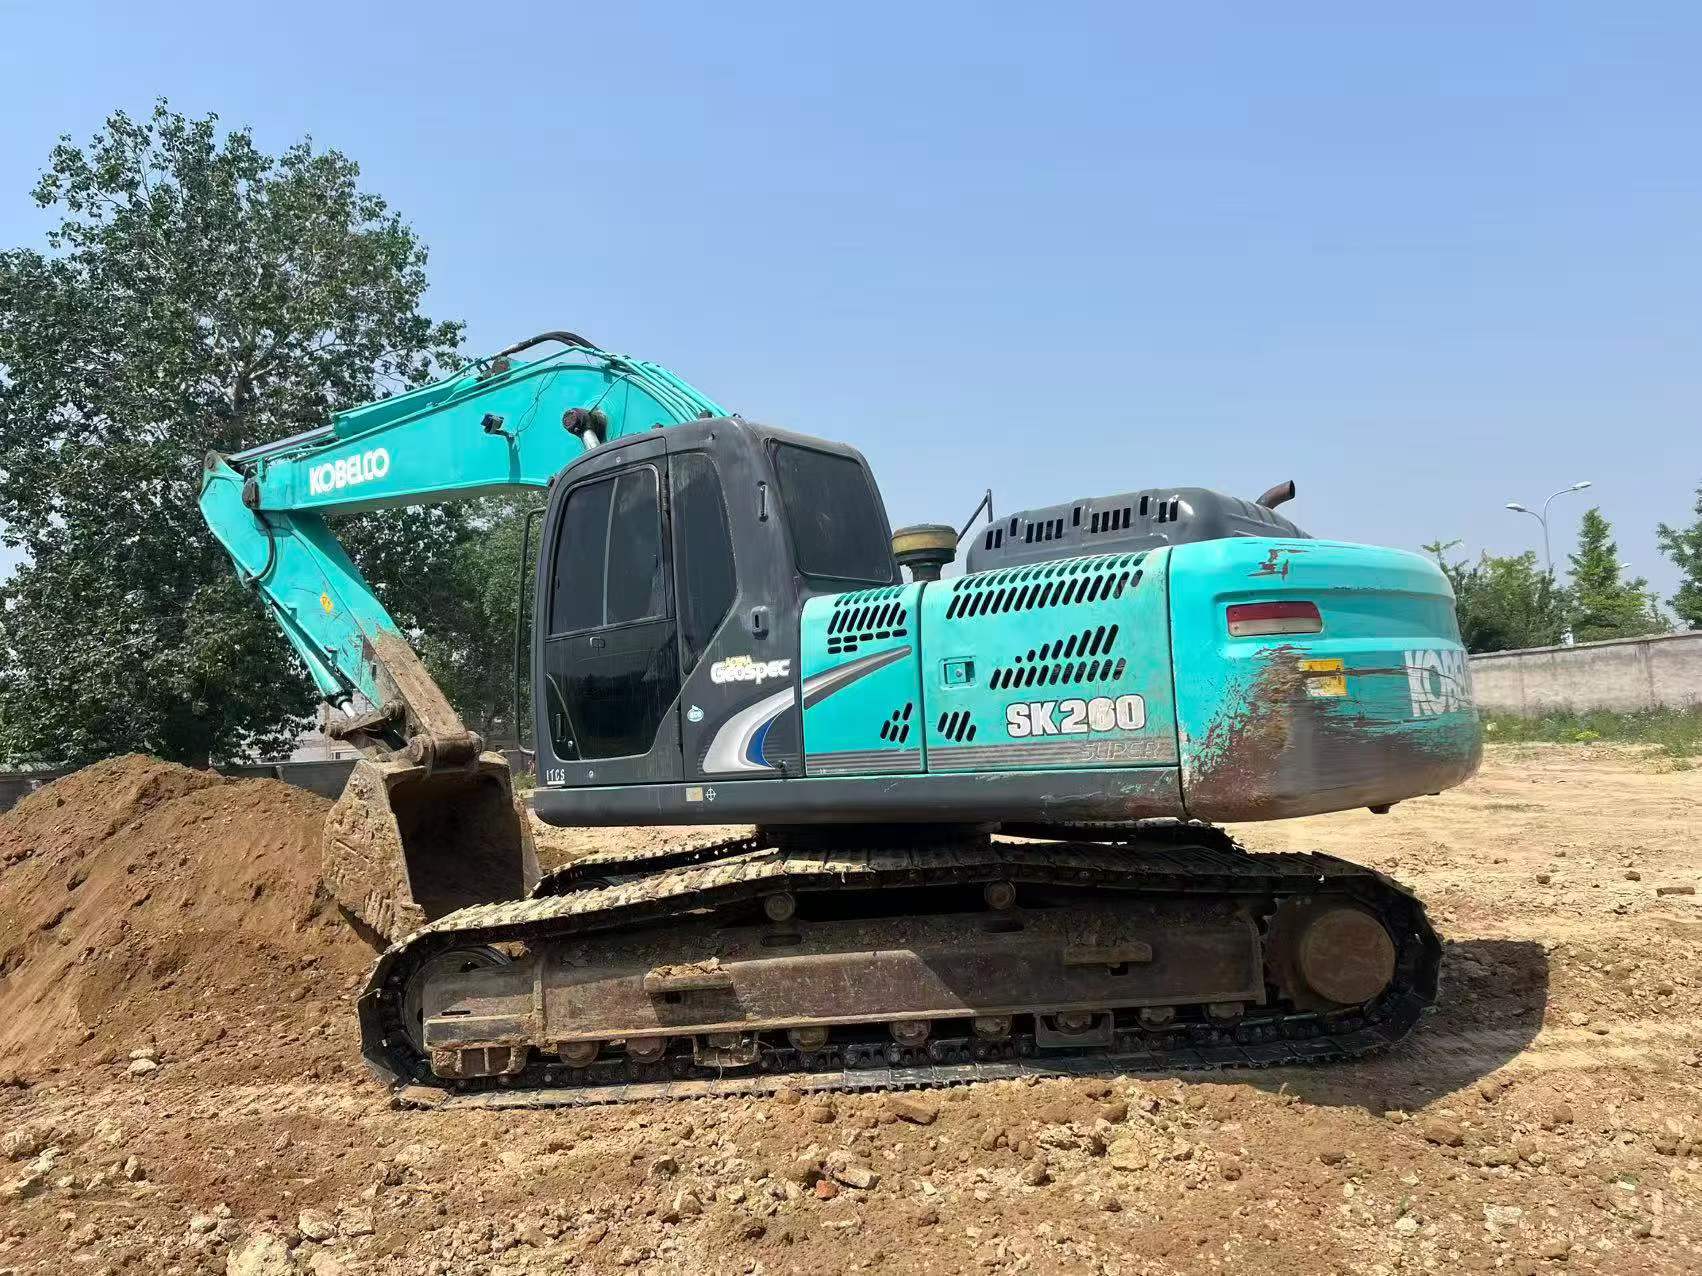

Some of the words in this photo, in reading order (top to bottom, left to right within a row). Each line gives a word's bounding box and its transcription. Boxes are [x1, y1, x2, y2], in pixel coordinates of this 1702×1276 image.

[310, 447, 390, 496] KOBELCO
[1006, 694, 1145, 738] SK260
[1082, 739, 1160, 761] SUPER
[546, 768, 565, 782] ITCS
